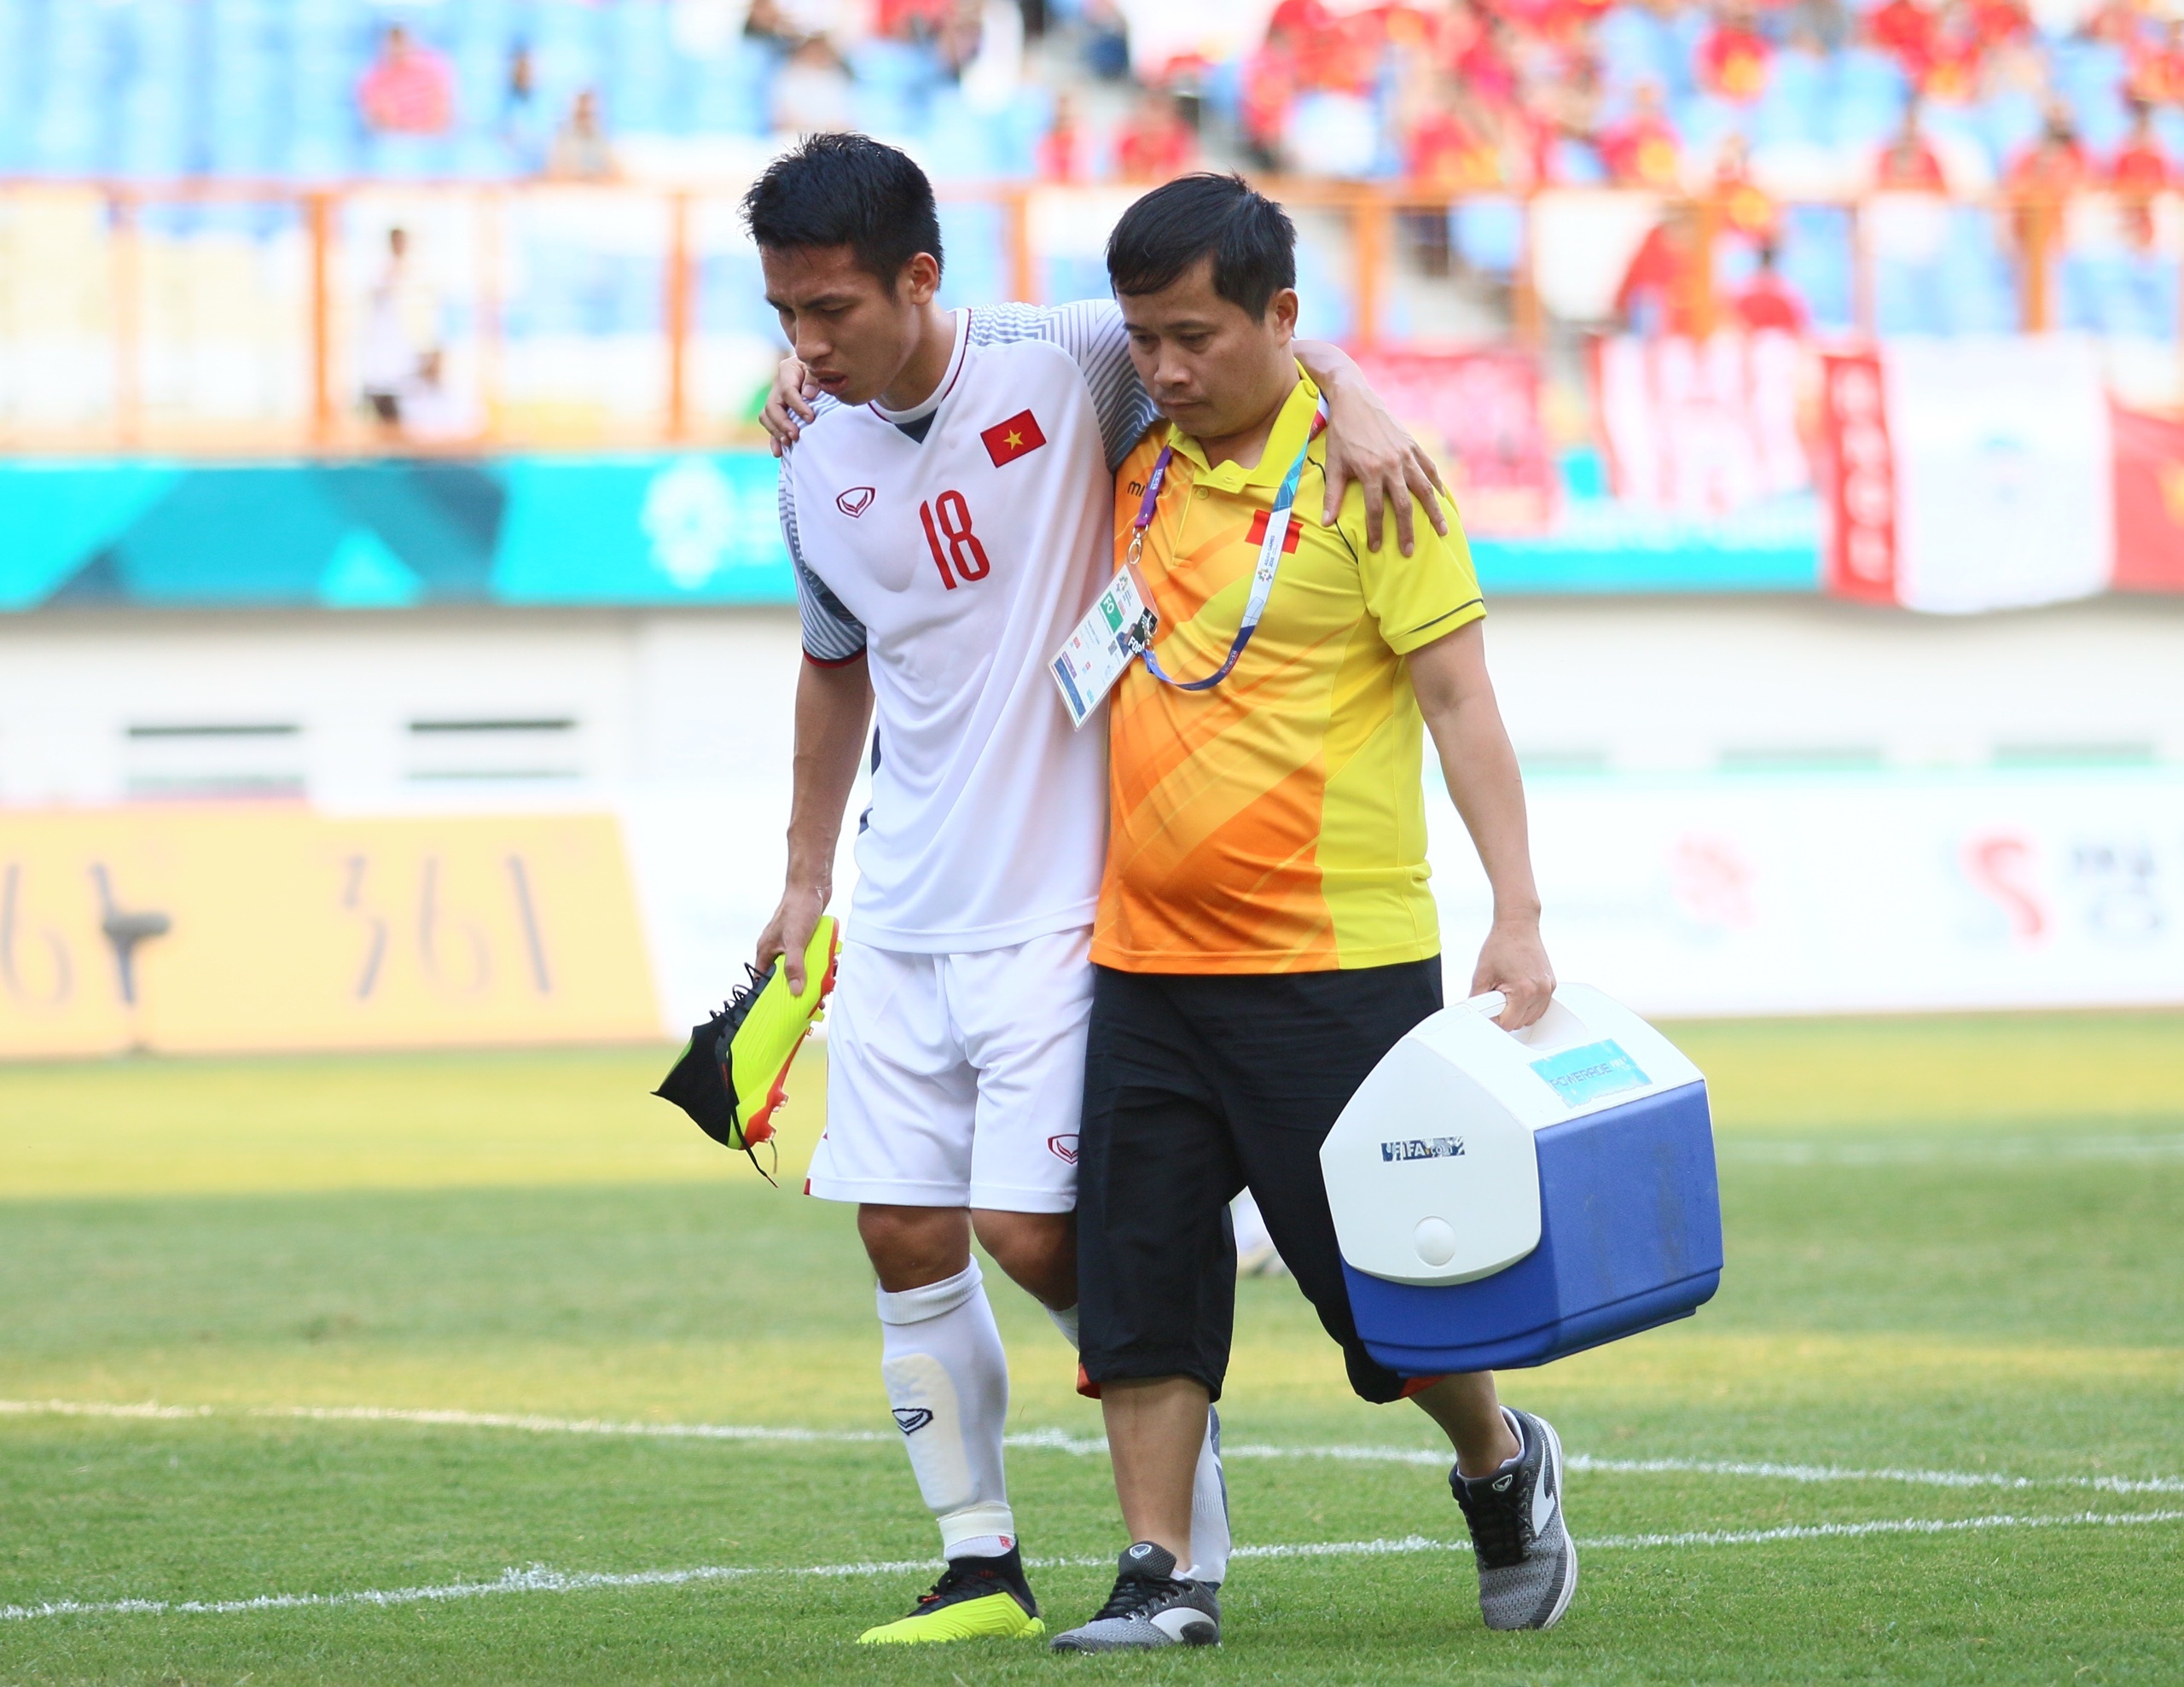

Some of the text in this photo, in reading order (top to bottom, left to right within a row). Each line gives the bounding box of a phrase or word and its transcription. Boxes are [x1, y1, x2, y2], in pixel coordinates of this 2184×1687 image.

[919, 490, 990, 590] 18
[1103, 596, 1115, 614] FO
[1548, 1062, 1612, 1089] POWERADE
